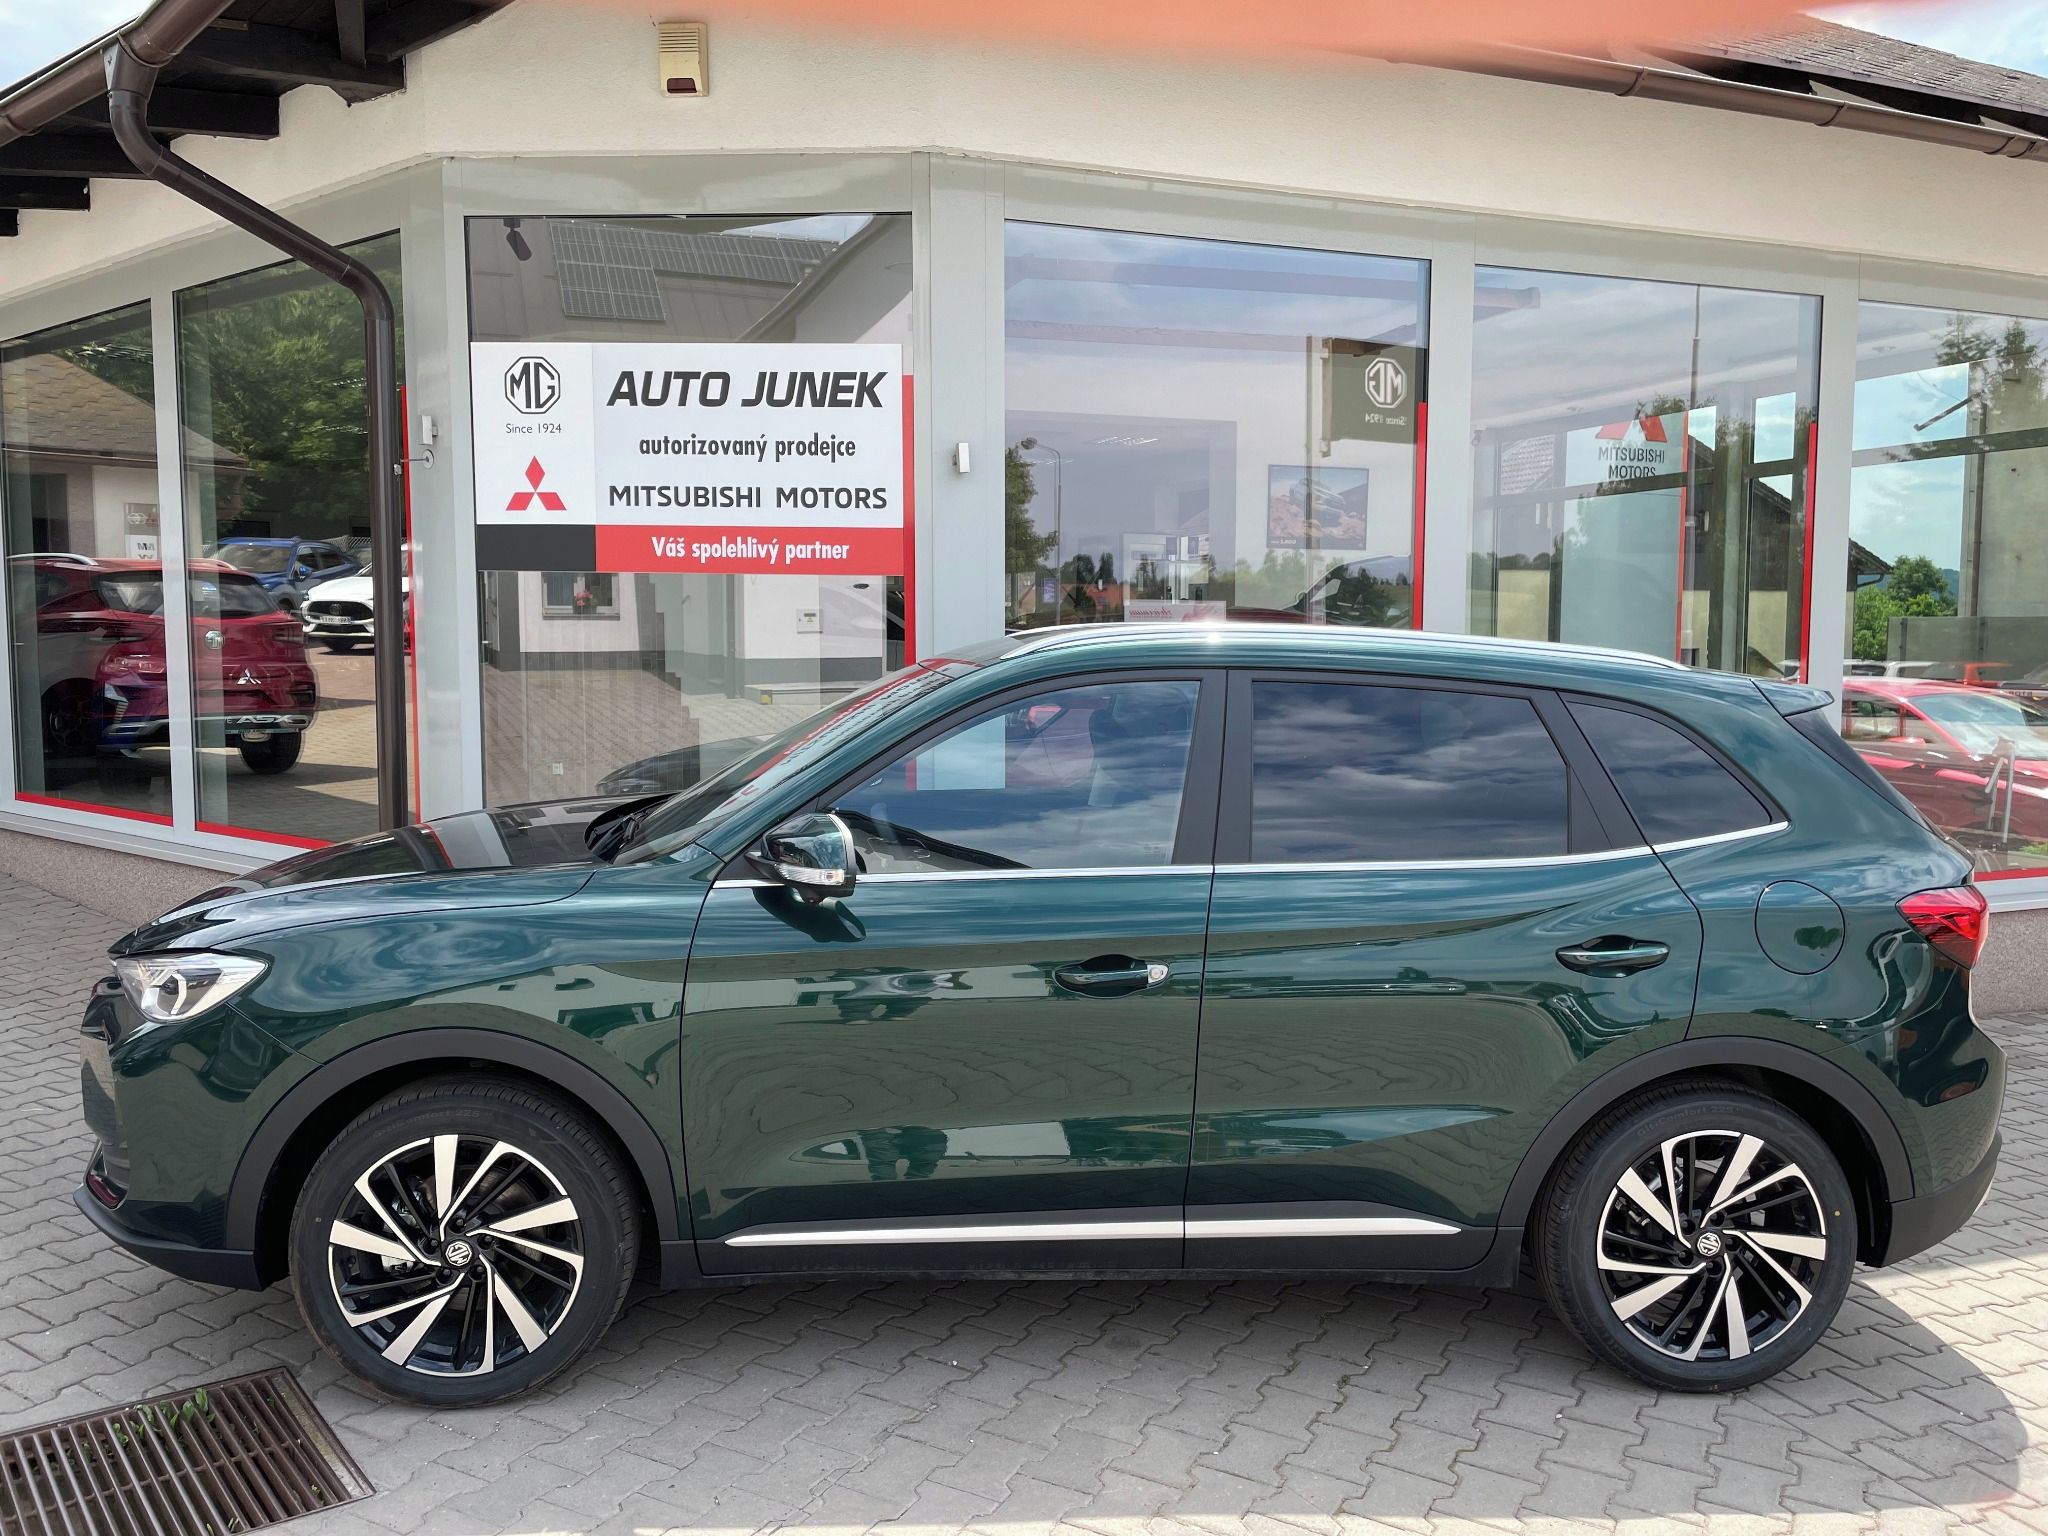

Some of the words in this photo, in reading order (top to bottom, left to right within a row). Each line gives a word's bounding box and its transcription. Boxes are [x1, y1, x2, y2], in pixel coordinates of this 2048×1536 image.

[507, 359, 558, 412] MG
[606, 370, 731, 407] AUTO
[740, 371, 888, 408] JUNEK
[505, 422, 533, 435] Since
[536, 422, 563, 435] 1924
[638, 433, 768, 462] autorizovaný
[774, 433, 856, 463] prodejce
[1597, 445, 1665, 463] MITSUBISHI
[1607, 464, 1657, 480] MOTORS
[608, 485, 762, 509] MITSUBISHI
[776, 487, 888, 510] MOTORS
[650, 536, 687, 558] Váš
[691, 537, 780, 565] spolehlivý
[784, 541, 850, 561] partner
[237, 714, 293, 724] ASX
[447, 1243, 471, 1265] MG
[1698, 1233, 1720, 1255] MG
